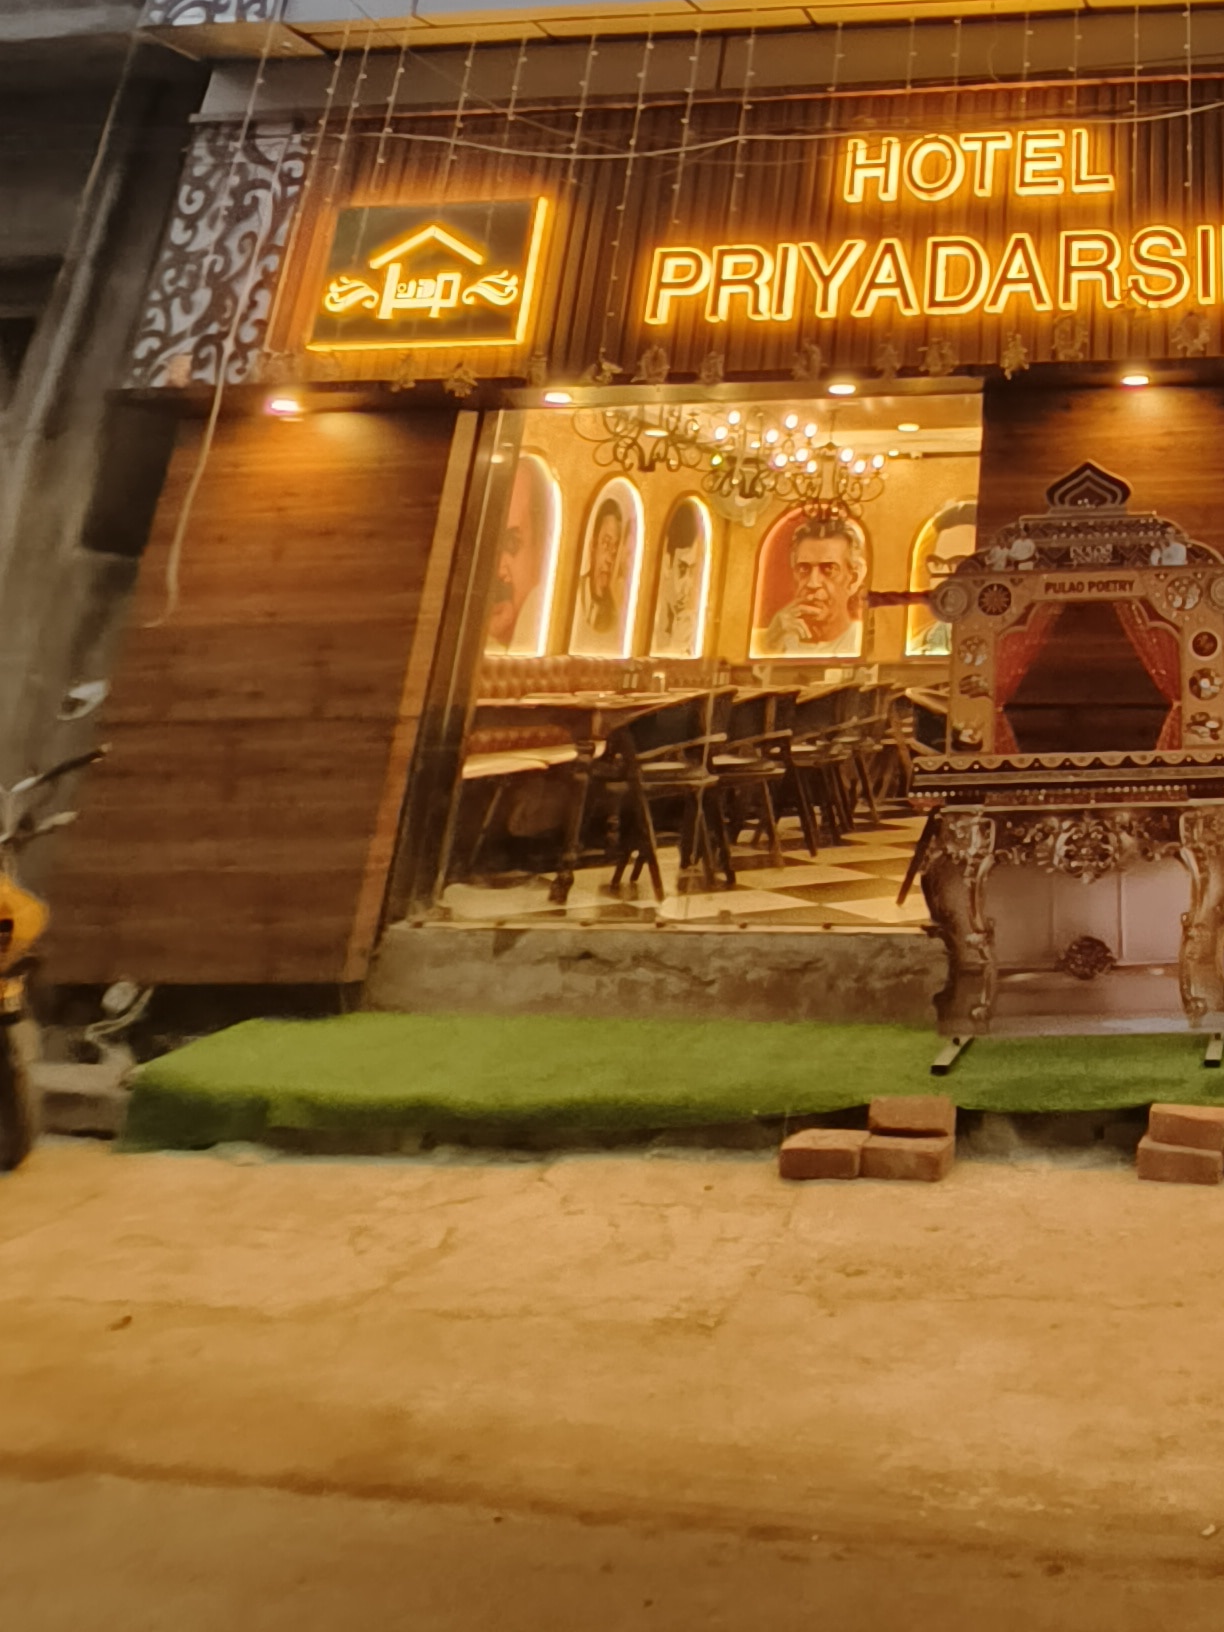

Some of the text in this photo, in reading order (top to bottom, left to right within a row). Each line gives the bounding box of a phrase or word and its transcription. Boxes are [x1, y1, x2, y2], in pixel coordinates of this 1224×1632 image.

[844, 130, 1114, 203] HOTEL
[1044, 579, 1135, 594] PULAO POETRY
